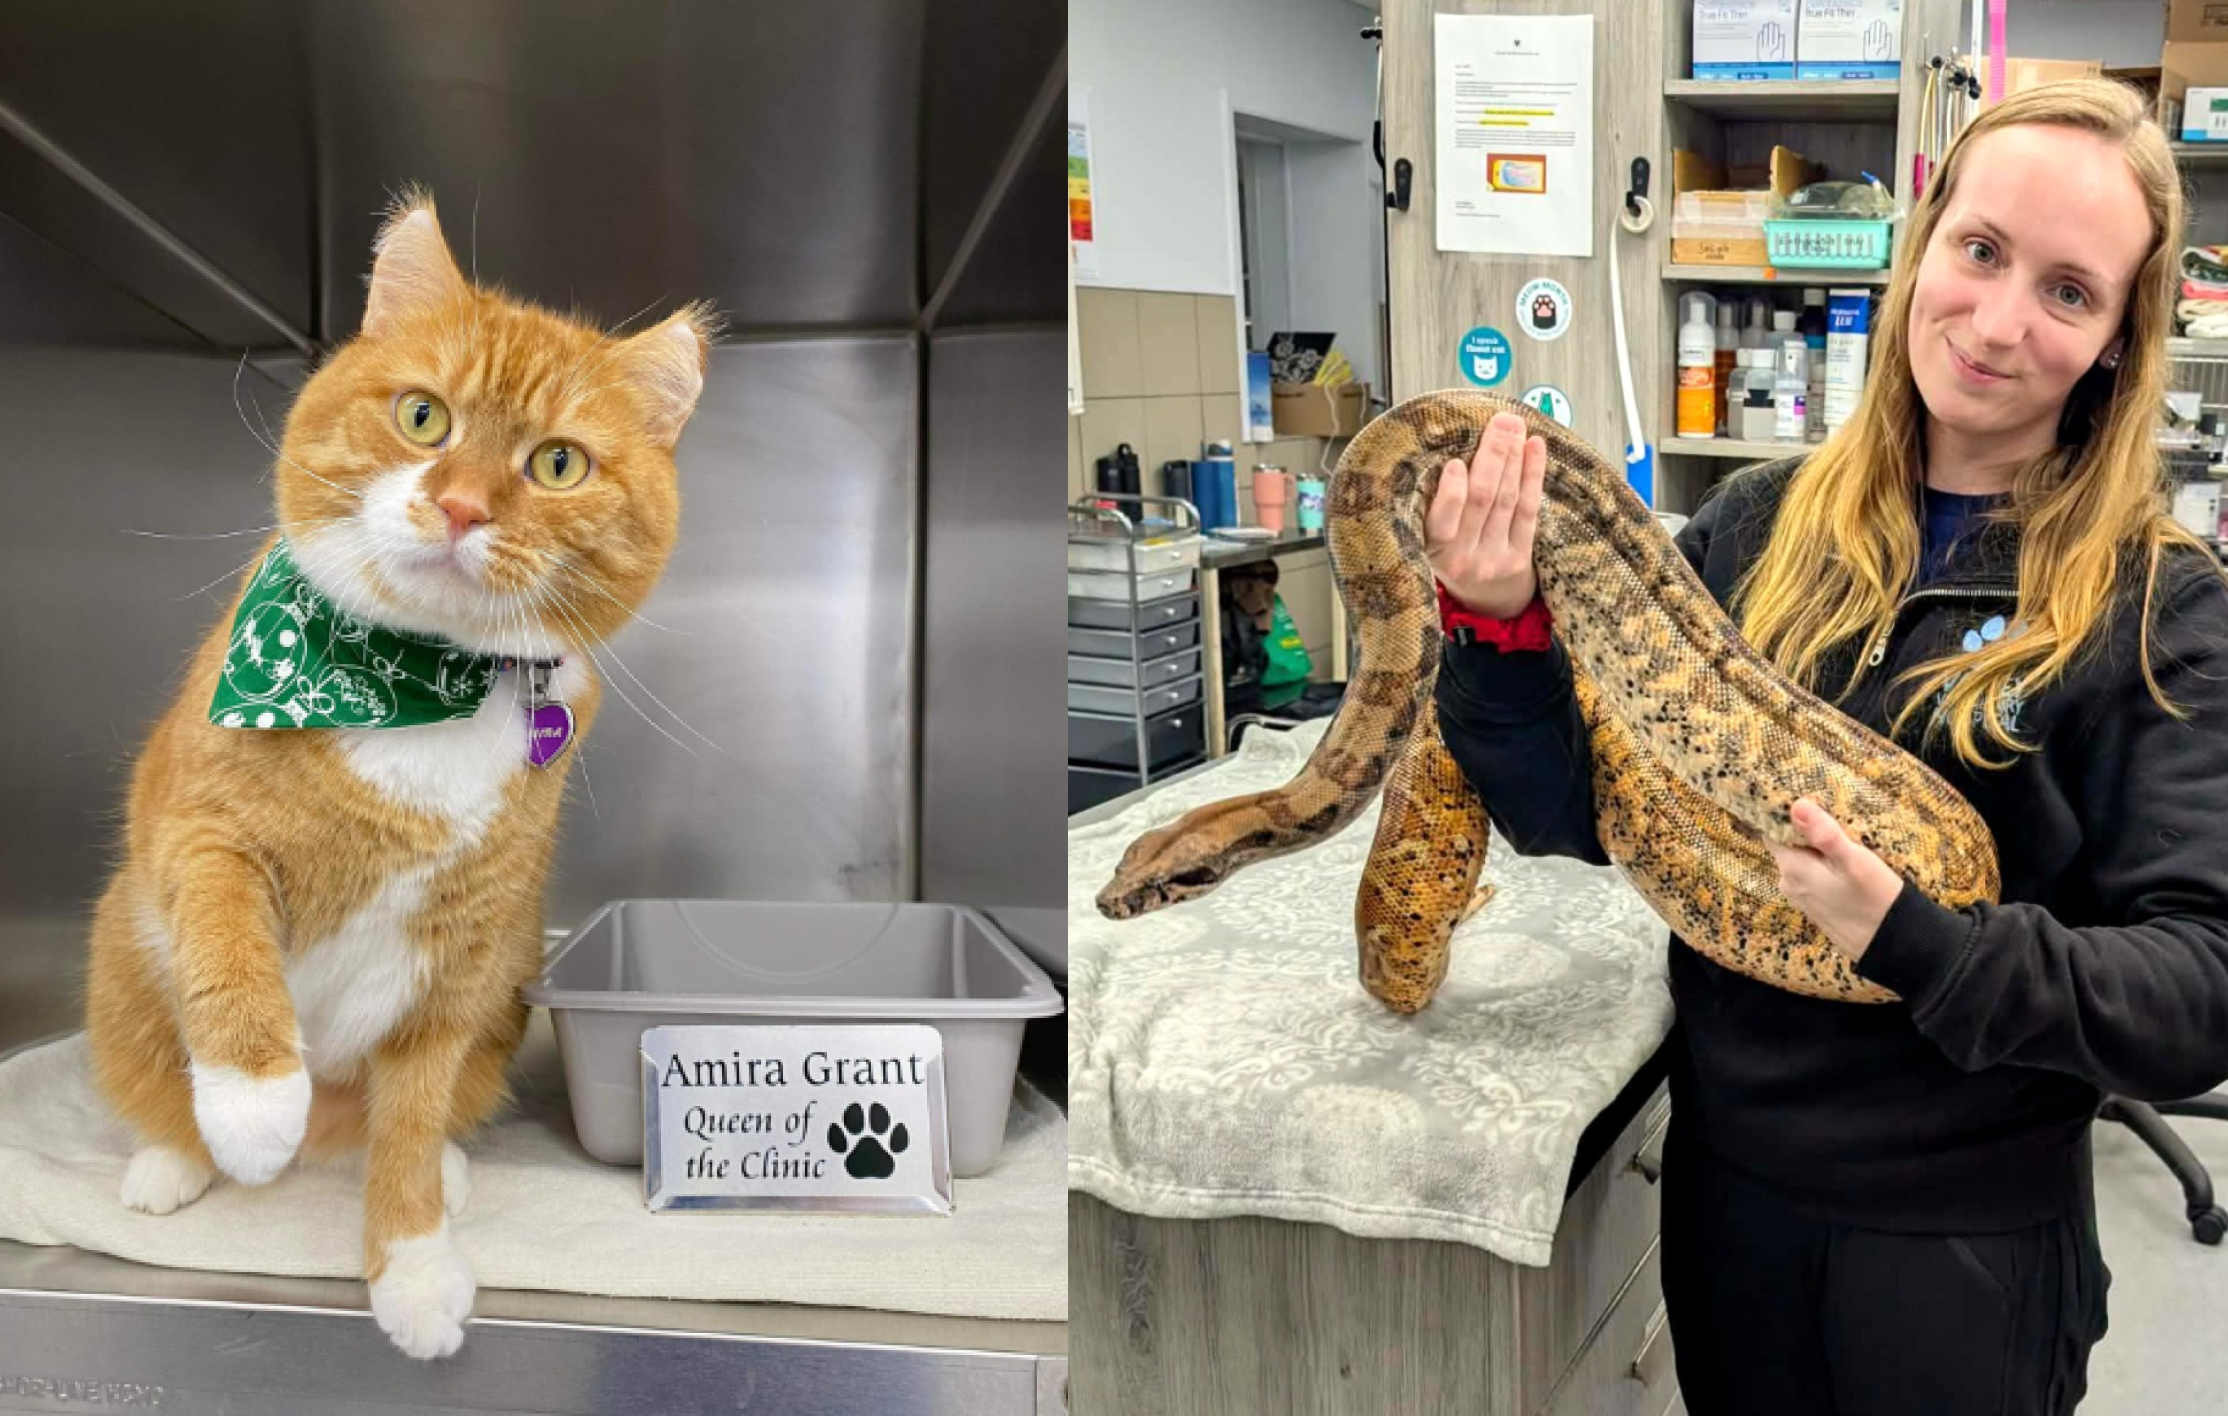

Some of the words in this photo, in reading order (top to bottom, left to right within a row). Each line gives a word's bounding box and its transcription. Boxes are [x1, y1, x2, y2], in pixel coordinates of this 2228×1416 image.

[1520, 283, 1540, 306] MEOW
[661, 1051, 788, 1087] Amira
[801, 1051, 926, 1087] Grant
[684, 1105, 773, 1142] Queen
[785, 1100, 818, 1147] of
[686, 1147, 730, 1180] the
[740, 1147, 828, 1180] Clinic
